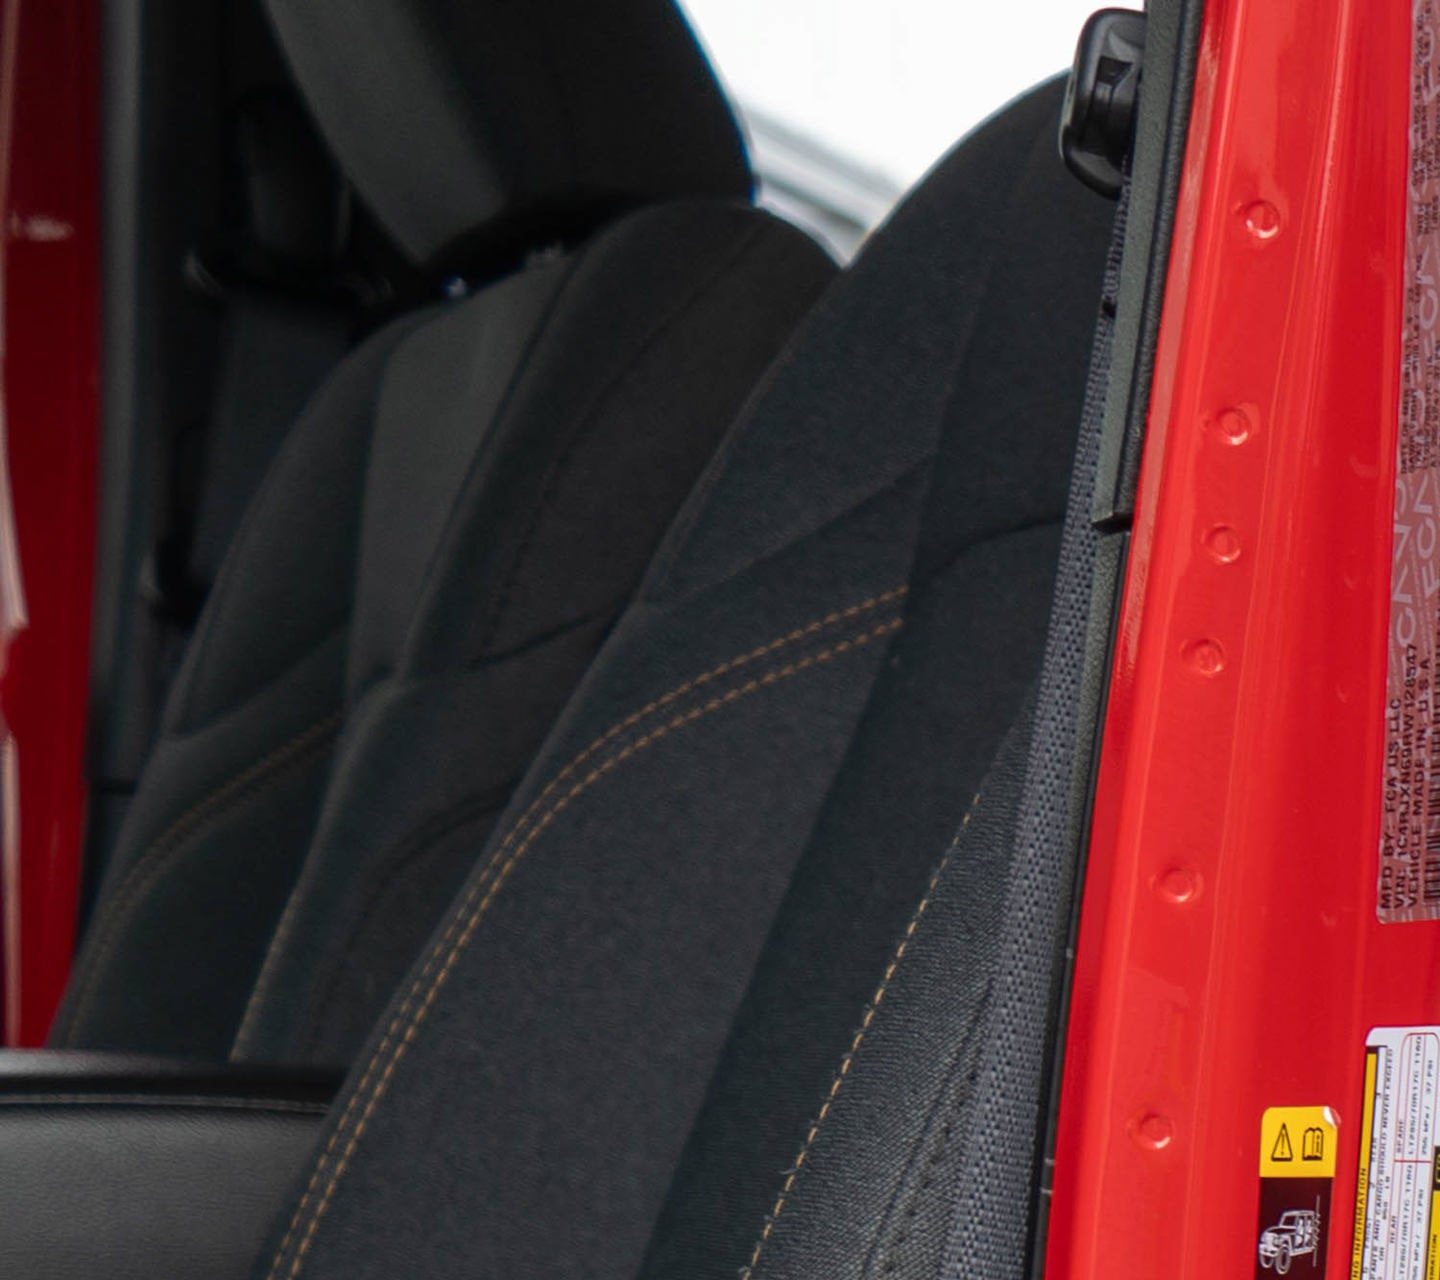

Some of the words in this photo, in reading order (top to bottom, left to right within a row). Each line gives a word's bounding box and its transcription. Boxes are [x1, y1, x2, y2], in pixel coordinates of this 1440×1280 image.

[1387, 698, 1401, 732] LLC
[1385, 740, 1398, 766] US
[1383, 776, 1397, 812] FCA
[1410, 758, 1425, 815] MADE
[1378, 865, 1392, 908] MFD
[1405, 824, 1422, 907] VEHICLE
[1352, 1167, 1368, 1256] INFORMATION
